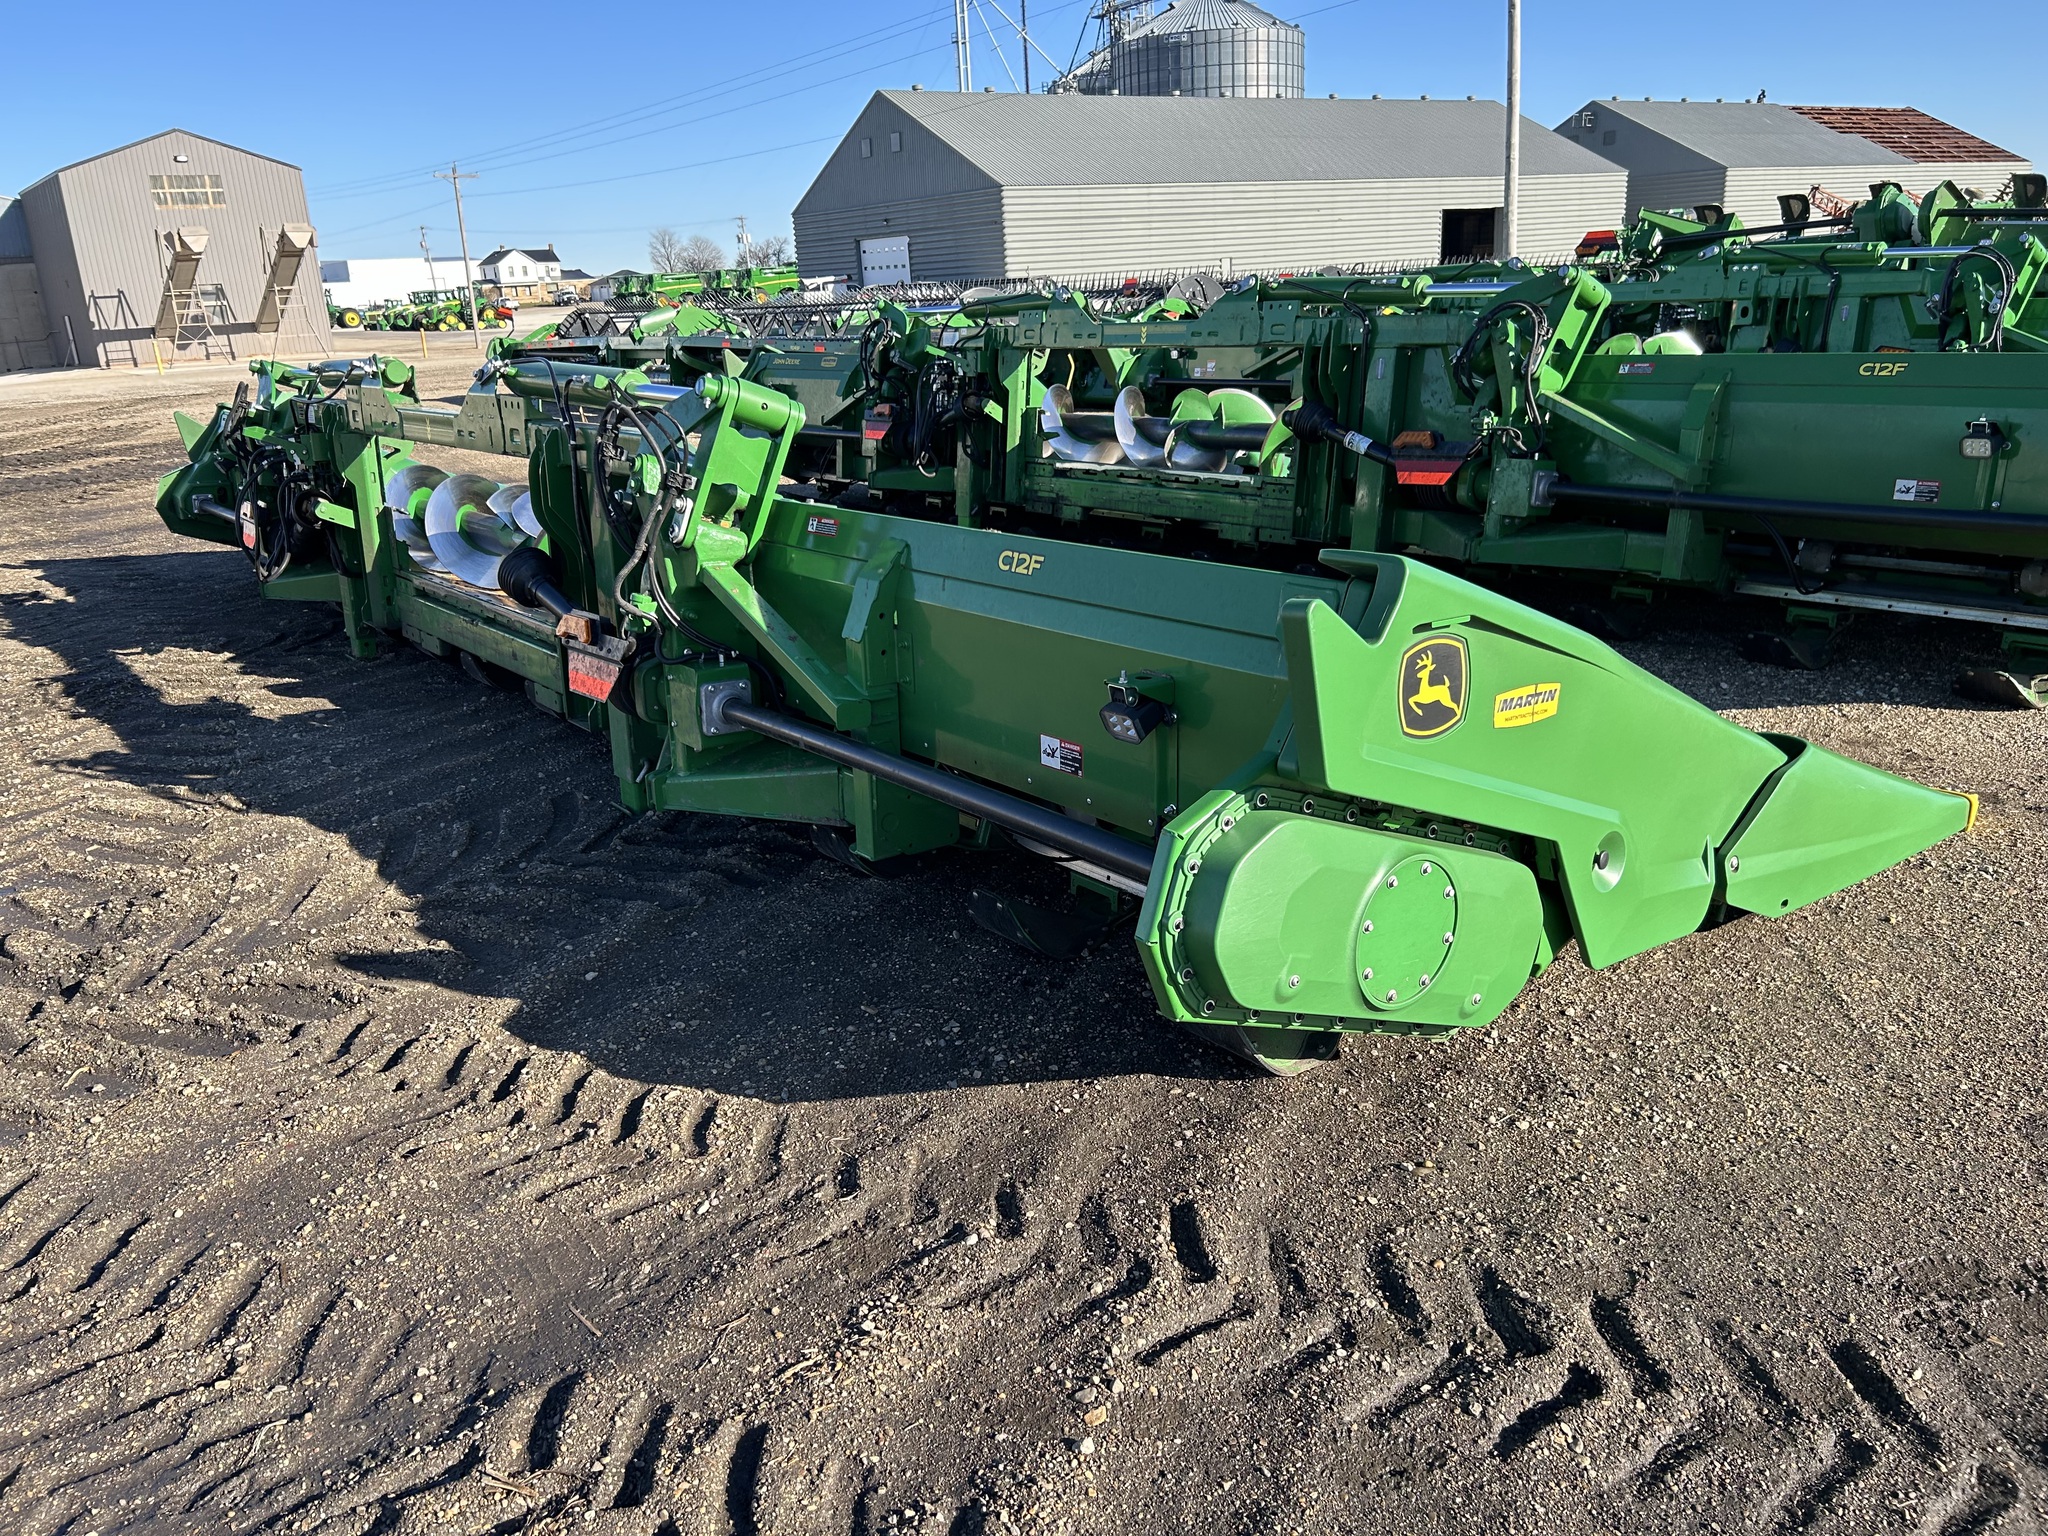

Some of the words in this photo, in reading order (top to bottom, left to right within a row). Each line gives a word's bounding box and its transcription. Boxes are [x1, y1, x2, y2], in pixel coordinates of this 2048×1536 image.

[785, 357, 801, 365] DEERE
[1858, 362, 1909, 376] C12F
[998, 550, 1045, 576] C12F
[1499, 688, 1558, 713] MARTIN
